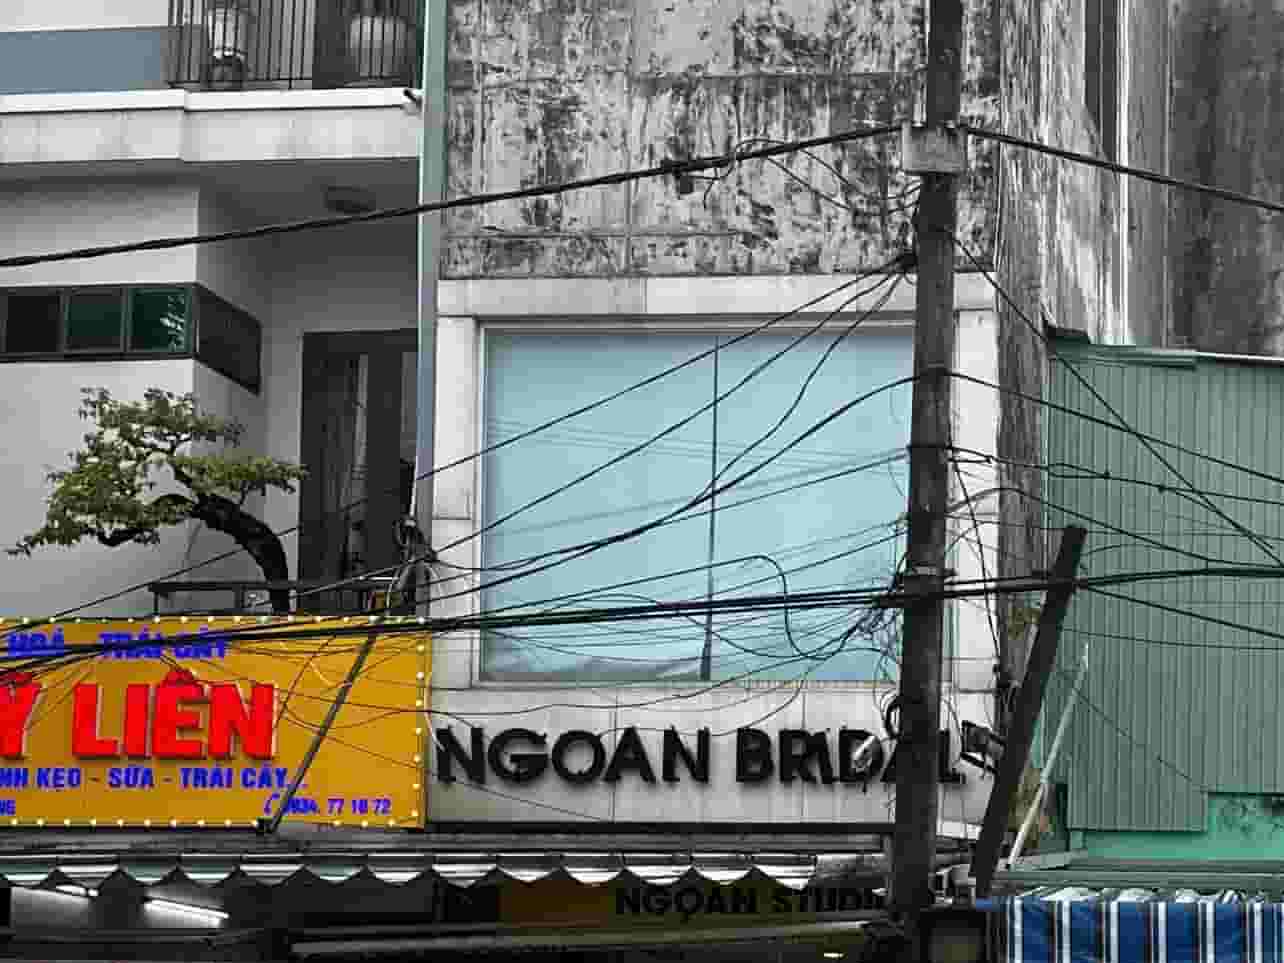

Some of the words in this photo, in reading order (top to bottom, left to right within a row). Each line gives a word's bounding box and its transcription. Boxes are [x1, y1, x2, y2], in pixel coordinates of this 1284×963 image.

[72, 669, 275, 758] LIÊN
[436, 726, 710, 785] NGOAN
[736, 727, 967, 785] BRIDL
